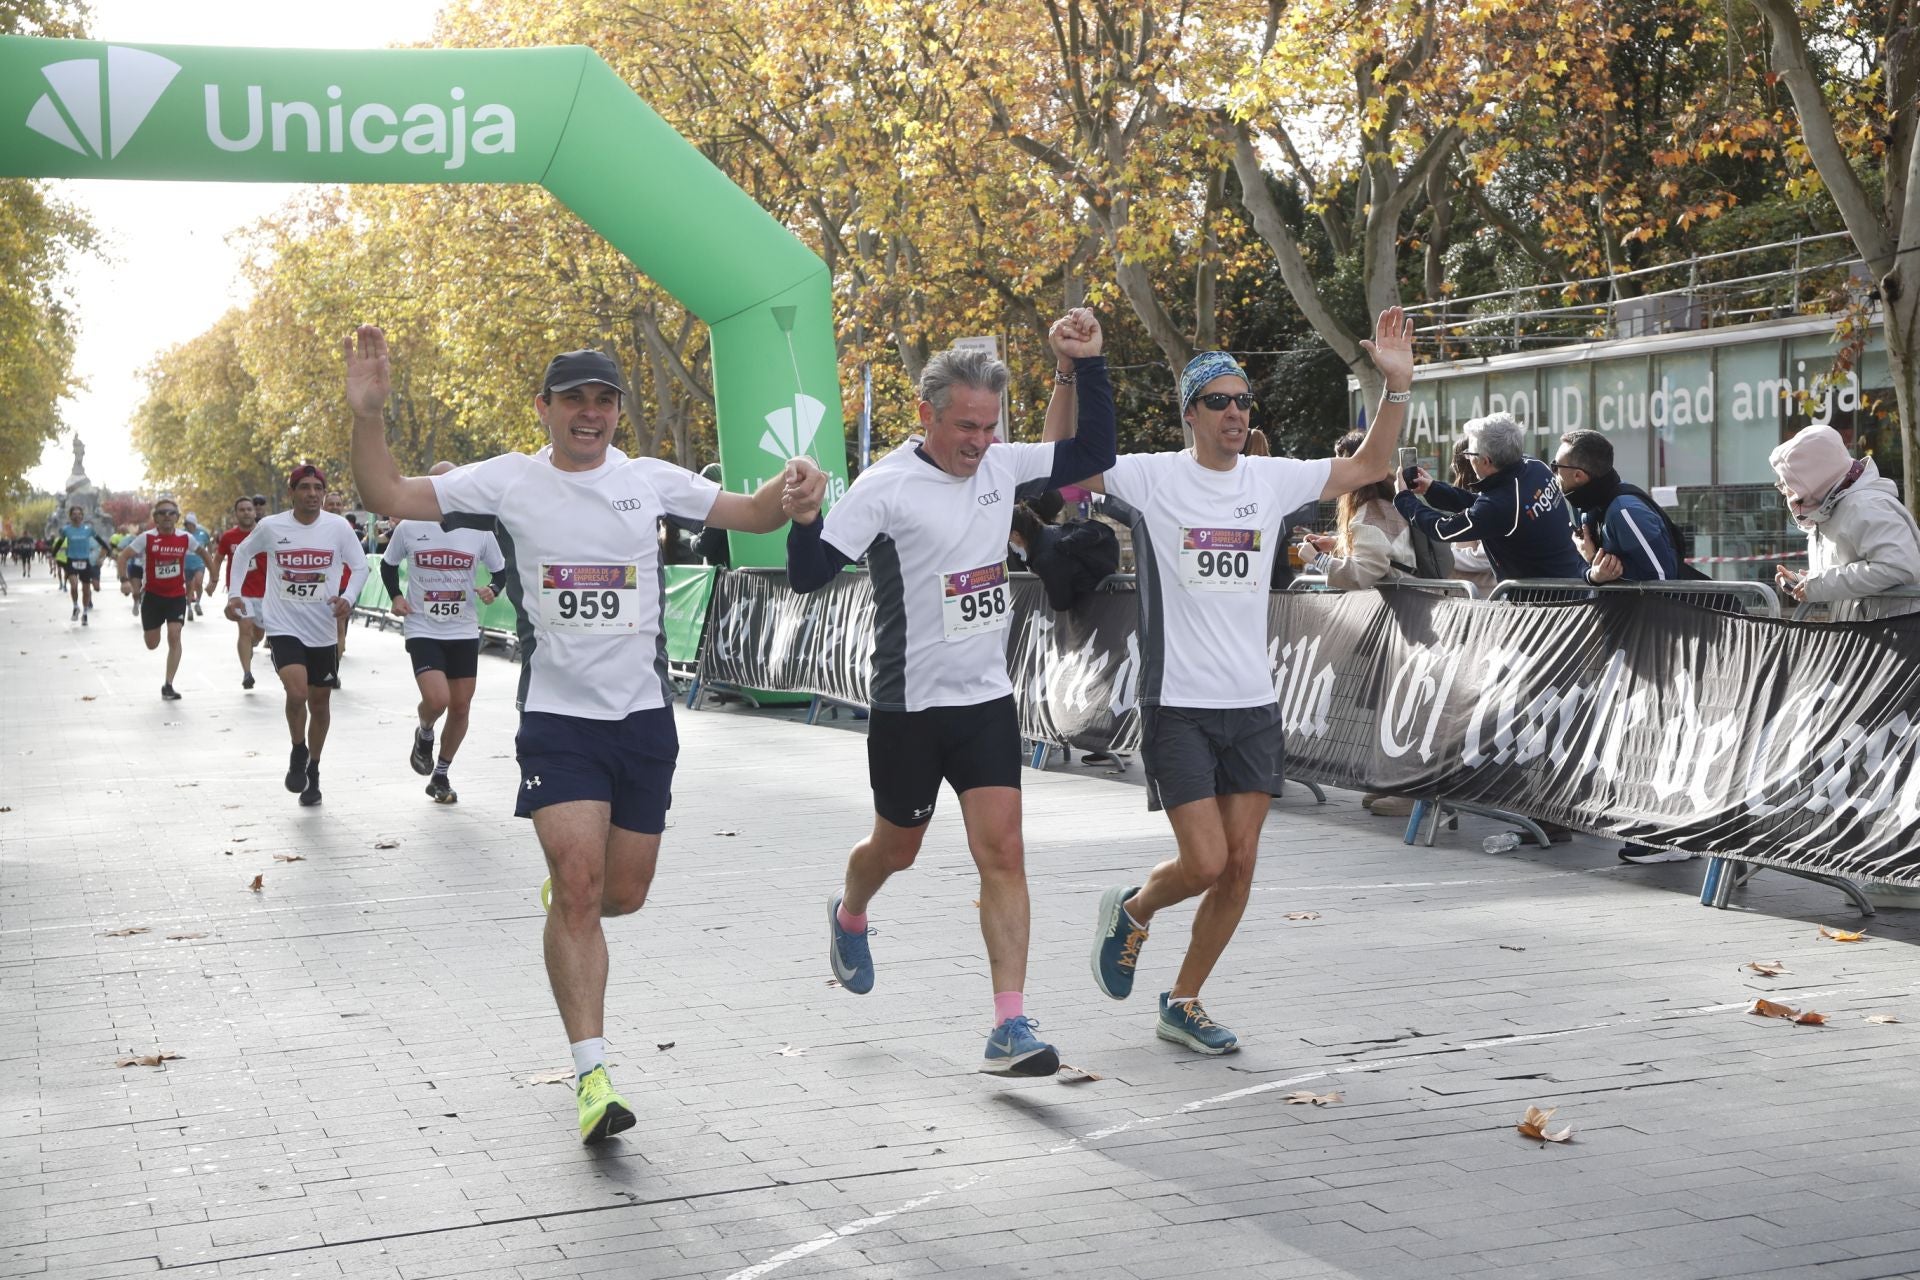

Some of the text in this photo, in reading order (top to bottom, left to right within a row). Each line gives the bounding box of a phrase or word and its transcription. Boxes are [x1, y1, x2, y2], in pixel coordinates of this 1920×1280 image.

[204, 84, 516, 169] Unicaja
[1599, 371, 1714, 431] ciudad
[1732, 362, 1862, 426] amiga
[159, 566, 176, 575] 264
[279, 554, 331, 566] Helios
[418, 554, 471, 568] Helios
[1197, 551, 1249, 578] 960
[286, 584, 318, 597] 457
[970, 574, 996, 585] EMPRESAS
[429, 603, 460, 616] 456
[558, 590, 620, 619] 959
[960, 587, 1006, 621] 958
[1460, 645, 1647, 783] Norte
[1652, 668, 1738, 815] de
[1105, 903, 1121, 938] HOKA
